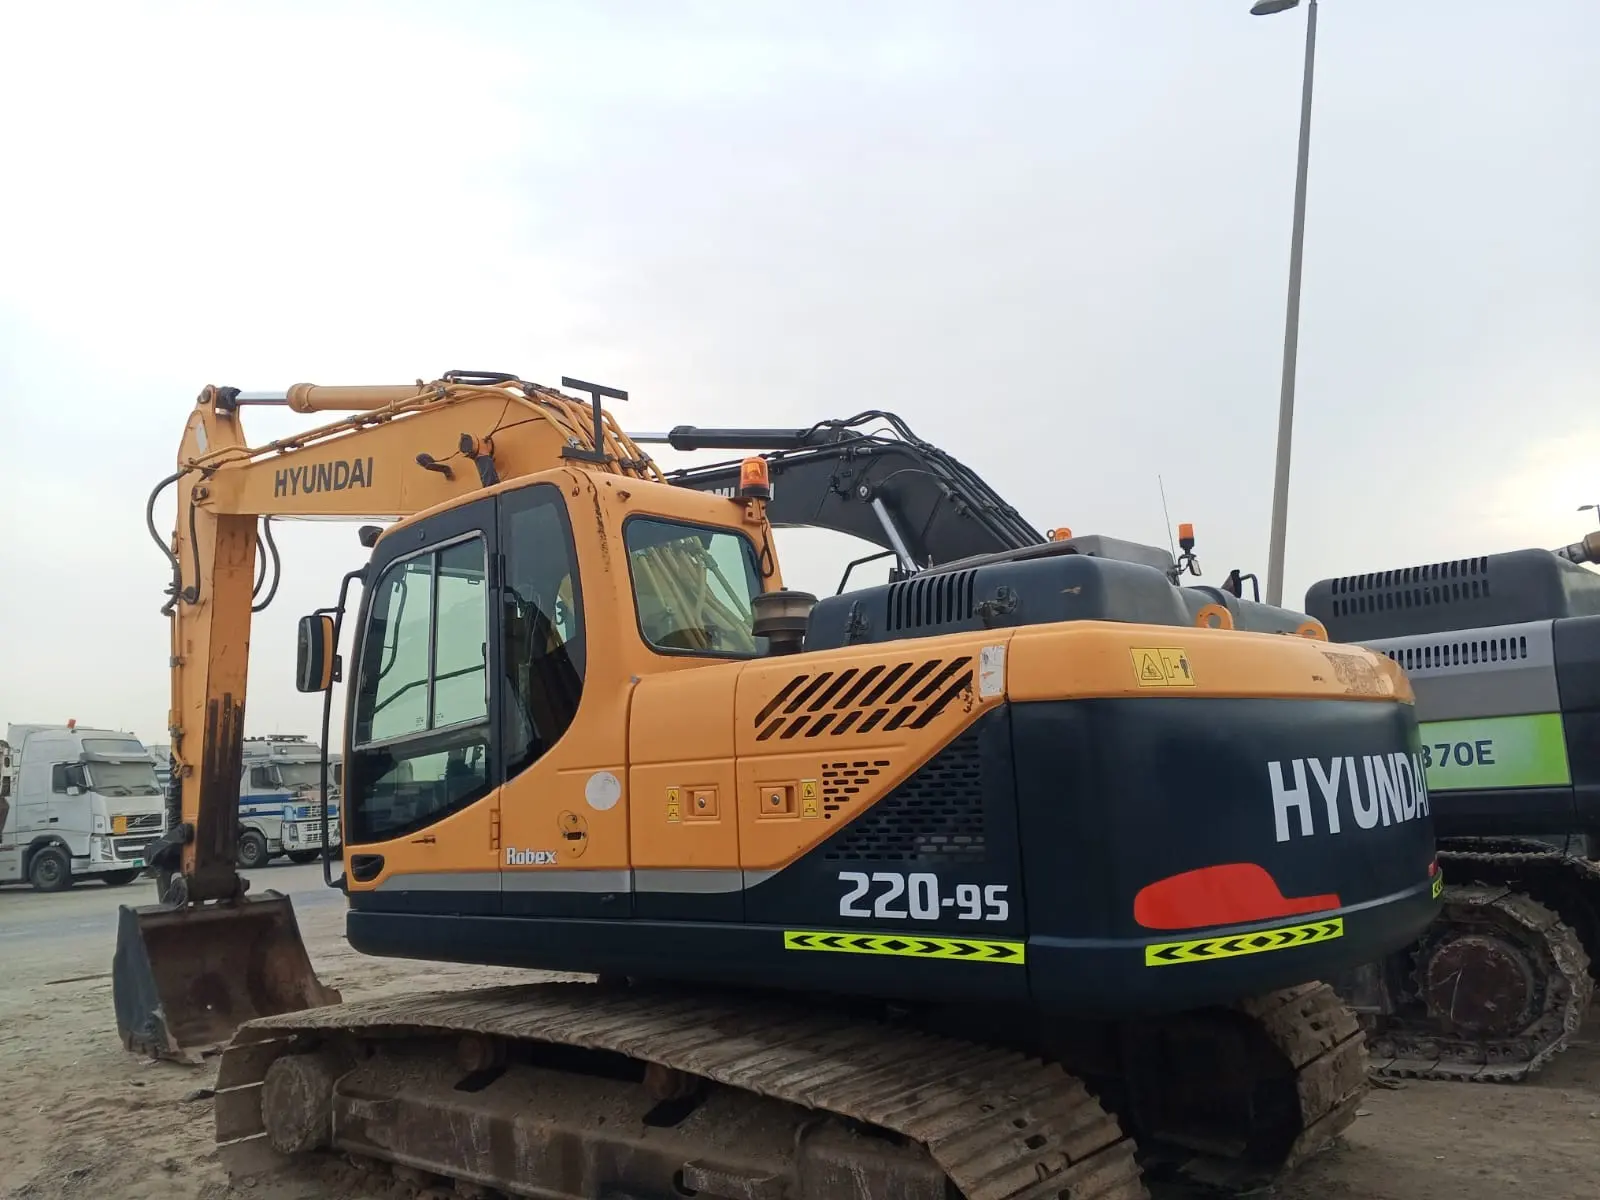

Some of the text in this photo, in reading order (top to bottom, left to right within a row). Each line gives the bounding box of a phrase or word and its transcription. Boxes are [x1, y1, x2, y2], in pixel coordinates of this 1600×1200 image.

[274, 457, 374, 498] HYUNDAI
[1267, 752, 1429, 842] HYUNDAI
[506, 847, 557, 865] Robex
